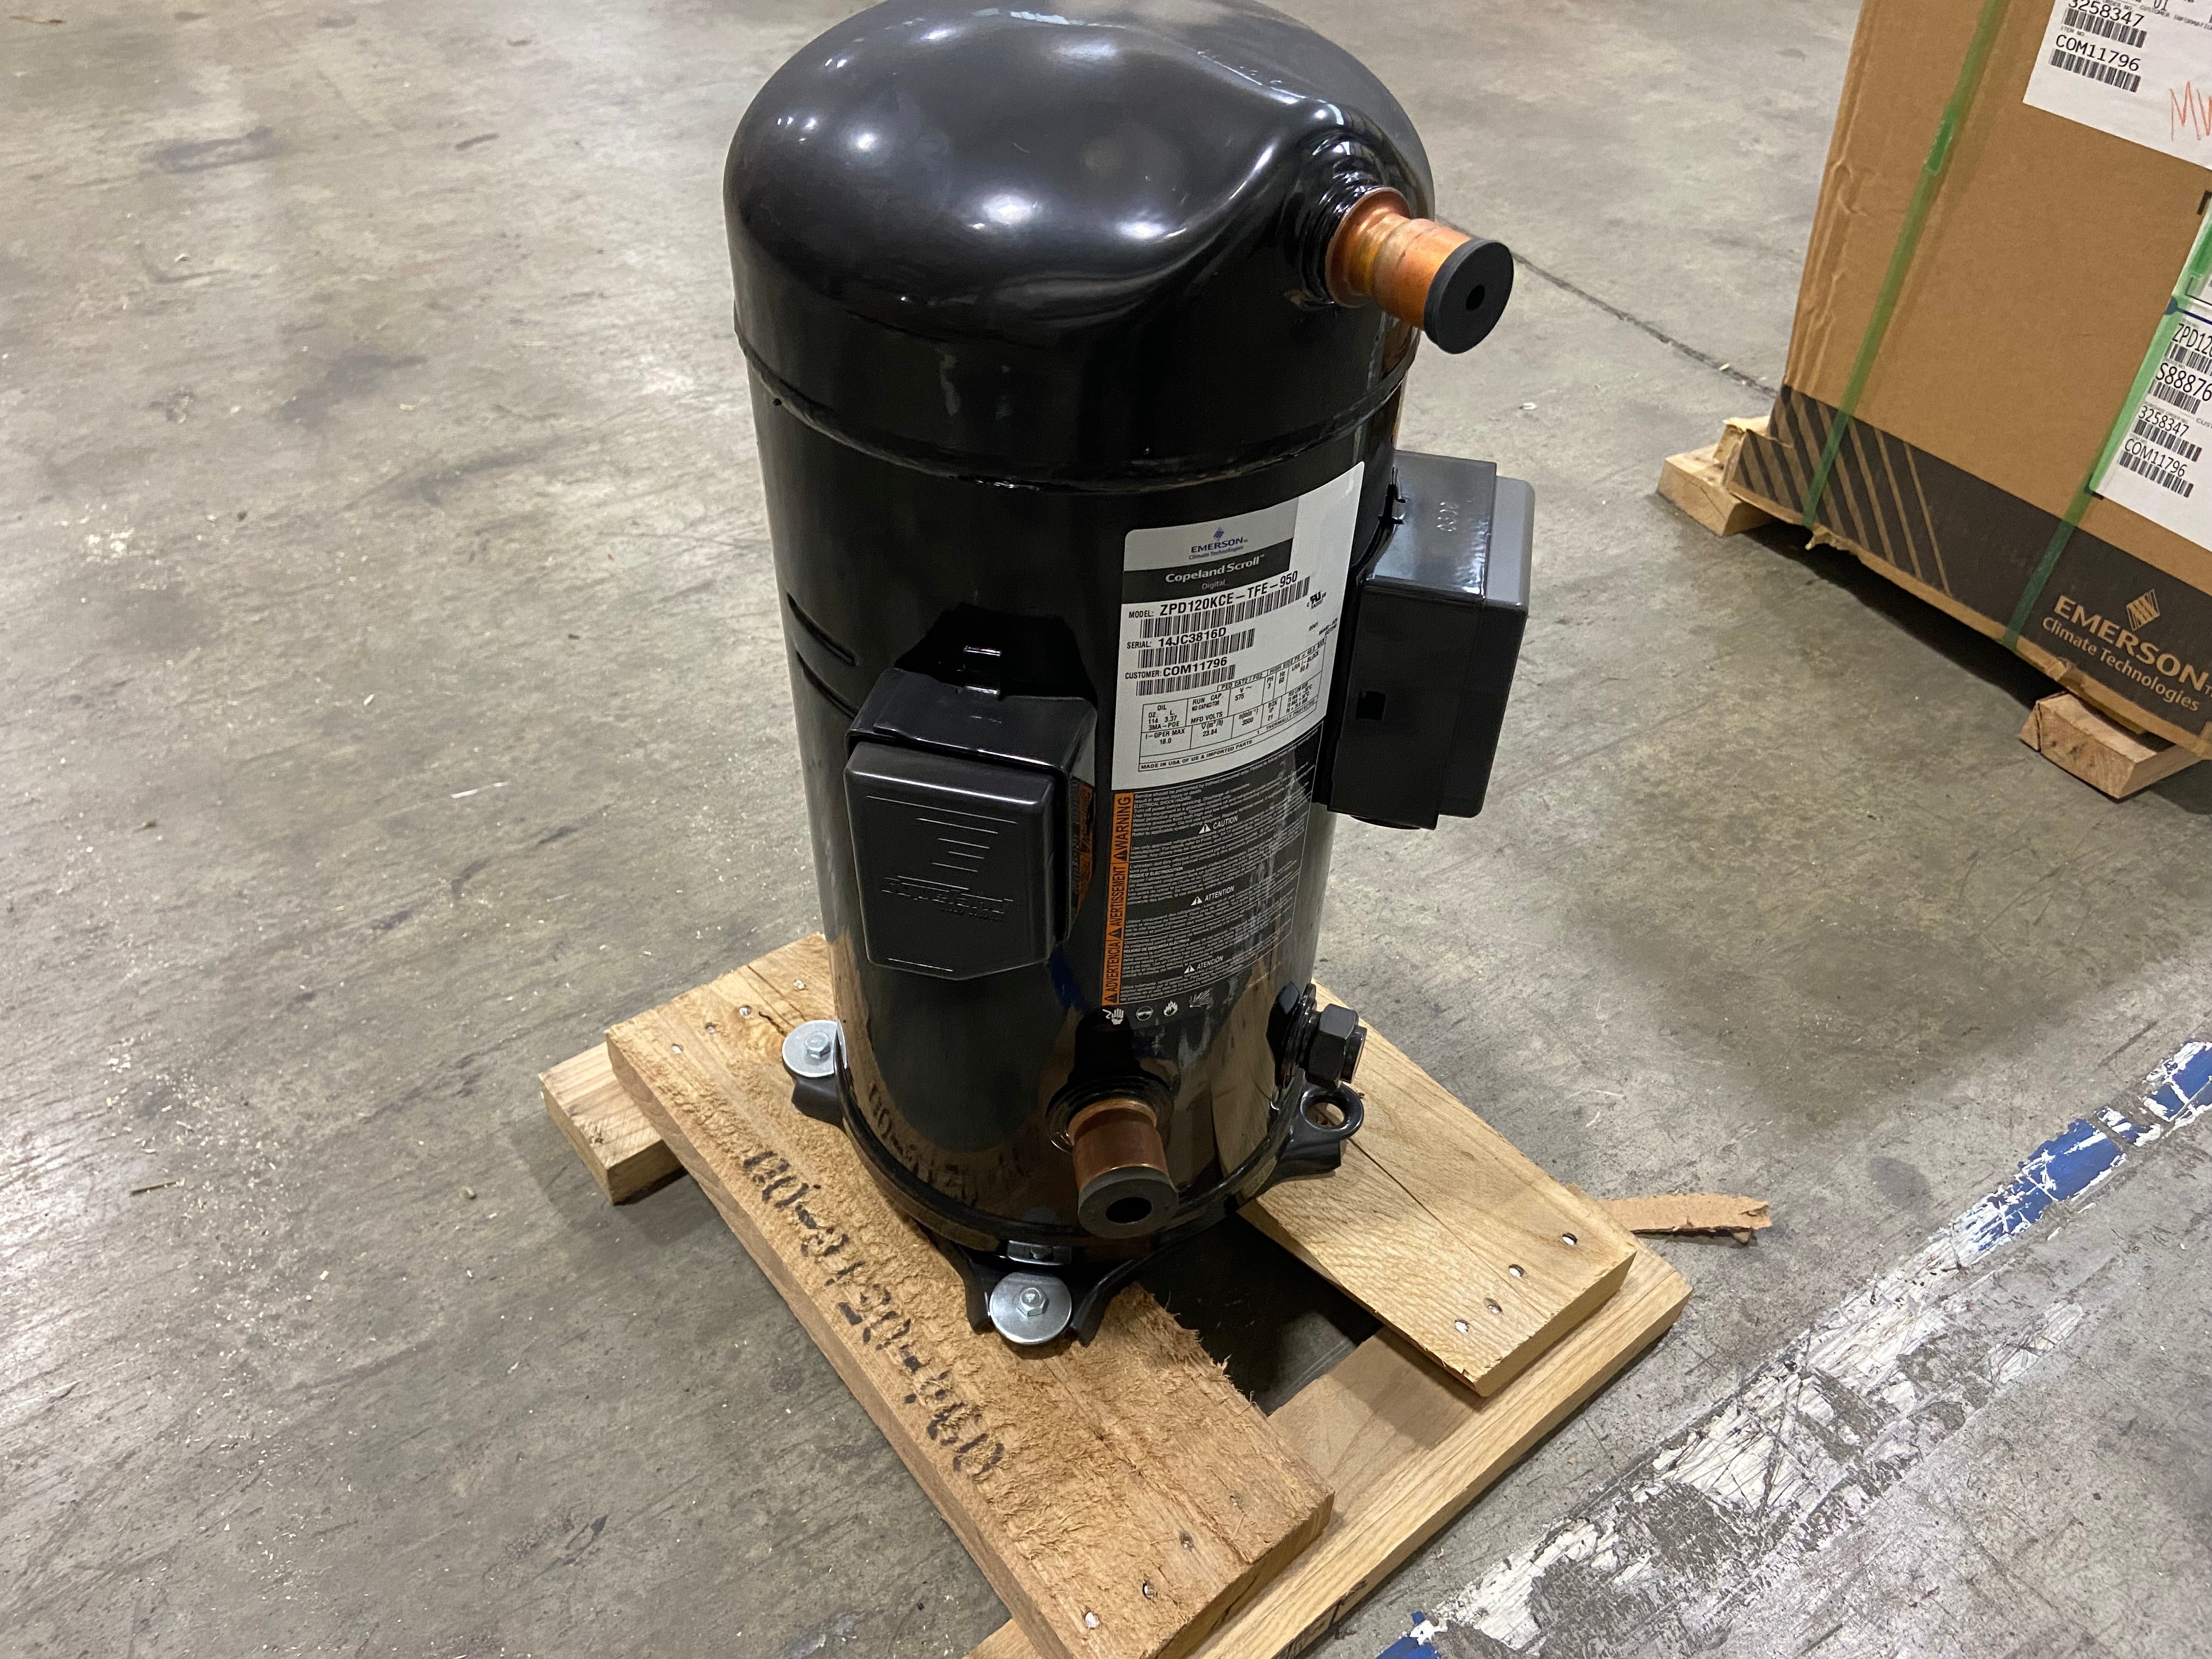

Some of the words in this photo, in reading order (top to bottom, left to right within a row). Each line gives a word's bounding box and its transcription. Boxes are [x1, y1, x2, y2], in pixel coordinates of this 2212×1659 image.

[2068, 0, 2145, 27] 3258347
[2056, 34, 2141, 71] COM11796
[2156, 362, 2212, 402] S88876
[2138, 405, 2190, 437] 3258347
[2124, 438, 2187, 477] COM11796
[1188, 552, 1209, 560] Climate
[1210, 545, 1244, 557] Technologies
[1190, 536, 1244, 554] EMERSON
[1165, 565, 1226, 583] Copeland
[1226, 556, 1260, 573] Scroll
[1201, 579, 1226, 590] Digital
[1128, 609, 1154, 619] MODEL:
[1126, 641, 1152, 650] SERIAL:
[1158, 627, 1227, 648] 14JC3816D
[2054, 595, 2209, 691] EMERSON
[1125, 670, 1162, 680] CUSTOMER:
[1163, 656, 1228, 677] COM11796
[2042, 617, 2097, 656] Climate
[2099, 647, 2199, 712] Technologies
[1192, 697, 1205, 705] RUN
[1205, 711, 1223, 721] VOLTS
[1171, 727, 1186, 736] MAX
[1206, 746, 1234, 758] IMPORTED
[1115, 797, 1131, 851] WARNING
[1213, 815, 1239, 830] CAUTION
[1109, 866, 1126, 927] AVERTISSEMENT
[1204, 885, 1235, 902] ATTENTION
[1105, 939, 1121, 992] ADVERTENCIA
